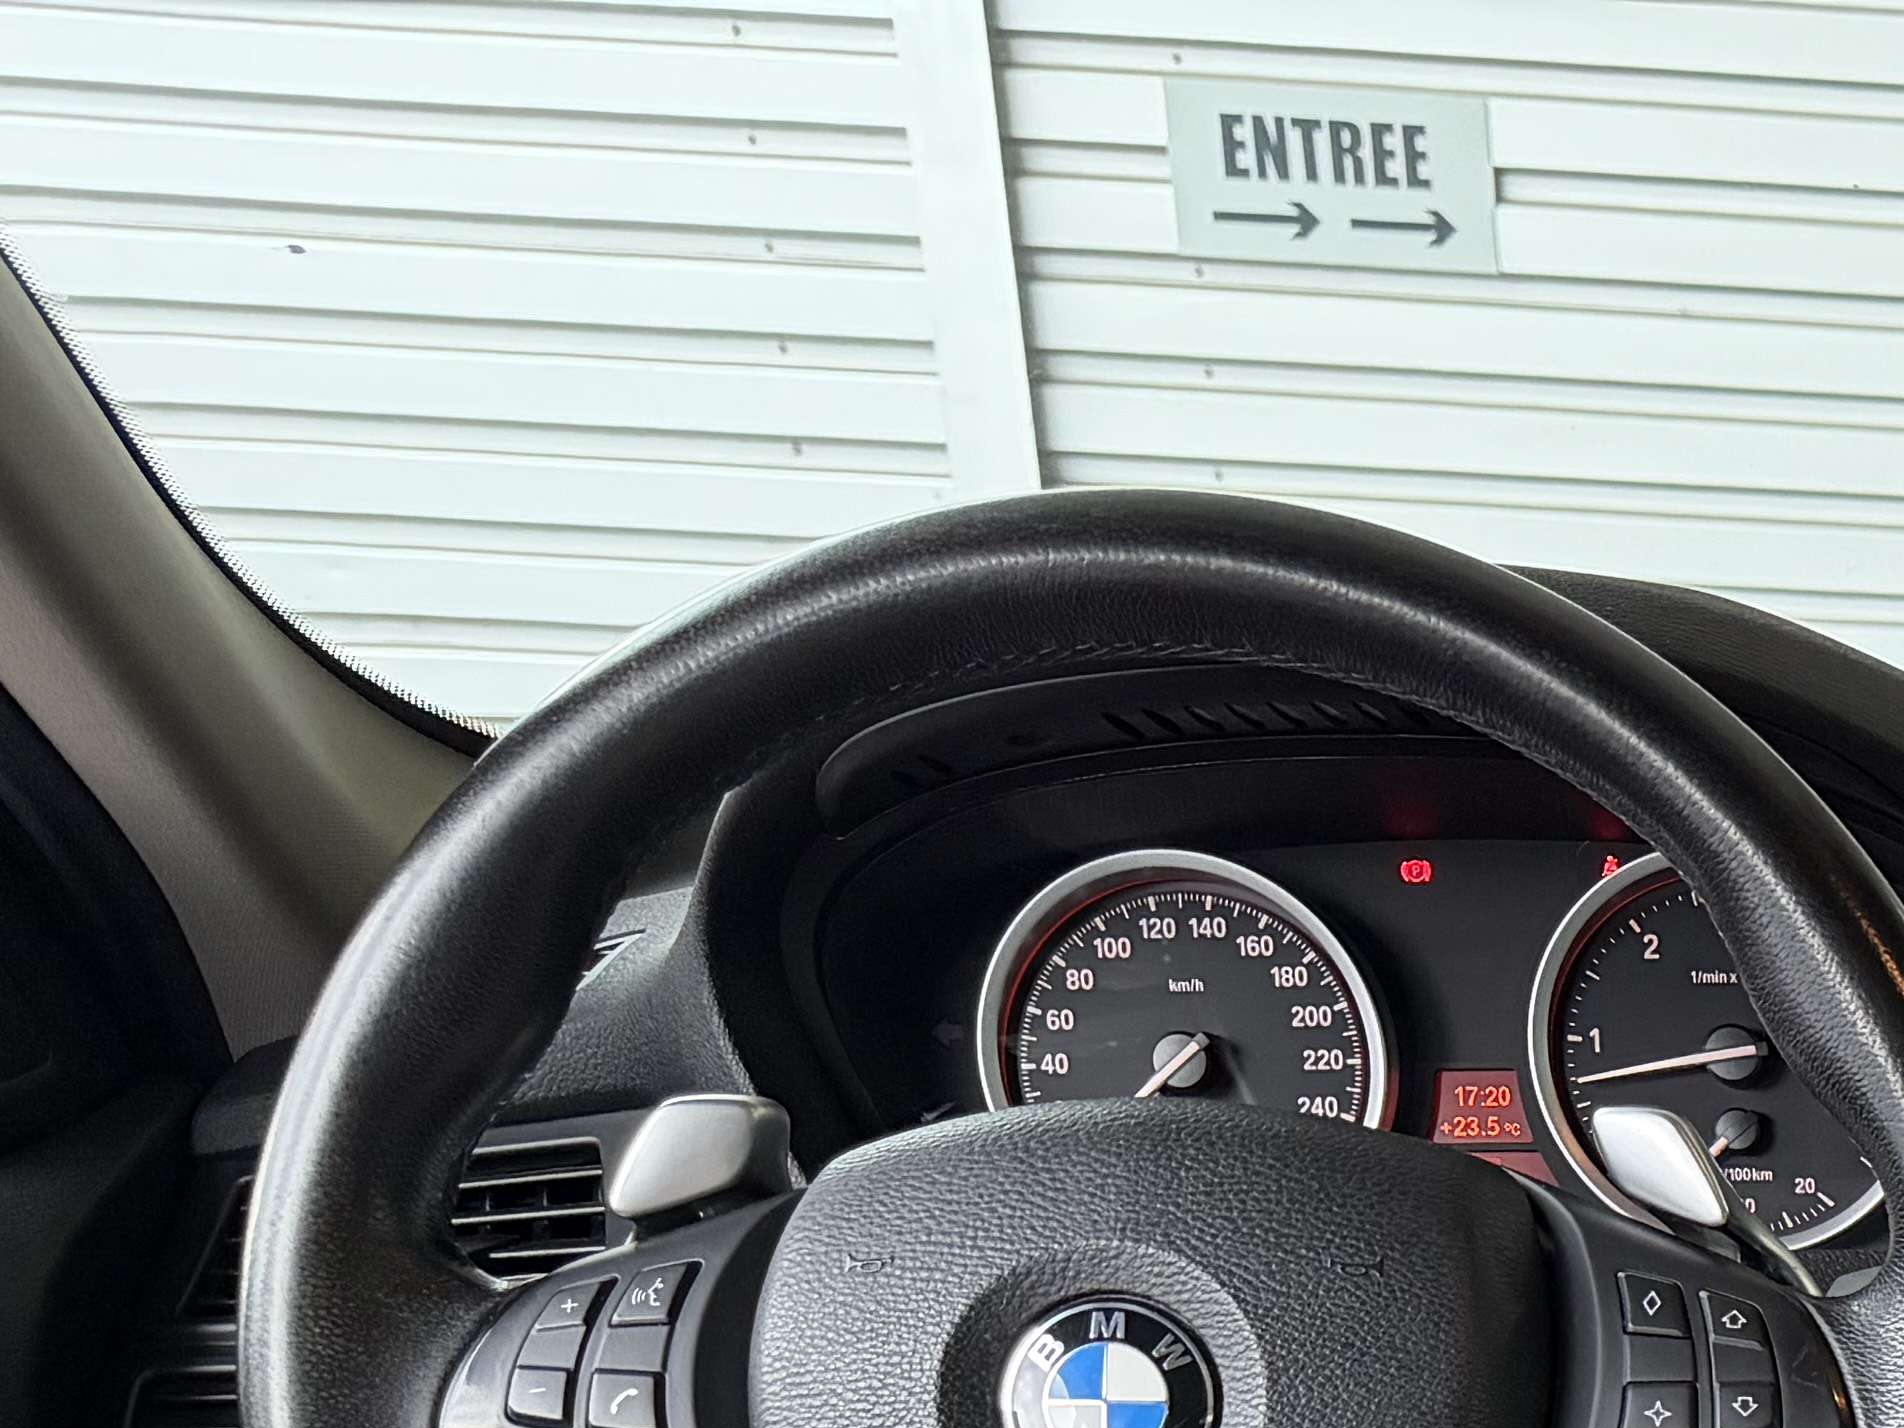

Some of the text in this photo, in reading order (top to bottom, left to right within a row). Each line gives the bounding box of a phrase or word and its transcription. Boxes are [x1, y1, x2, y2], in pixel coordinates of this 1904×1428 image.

[1219, 113, 1432, 189] ENTREE
[1139, 917, 1176, 939] 120
[1189, 916, 1226, 939] 140
[1093, 937, 1131, 959] 100
[1236, 935, 1274, 958] 160
[1643, 934, 1661, 959] 2
[1066, 969, 1094, 991] 80
[1168, 977, 1205, 993] km/h
[1271, 966, 1308, 989] 180
[1691, 970, 1727, 985] 1/min
[1046, 1010, 1074, 1031] 60
[1291, 1005, 1332, 1027] 200
[1589, 1028, 1602, 1053] 1
[1040, 1053, 1069, 1075] 40
[1303, 1049, 1343, 1072] 220
[1298, 1096, 1338, 1119] 240
[1455, 1086, 1511, 1107] 17:20
[1440, 1116, 1500, 1136] +23.5
[1794, 1177, 1816, 1194] 20
[1028, 1311, 1193, 1373] BMW
